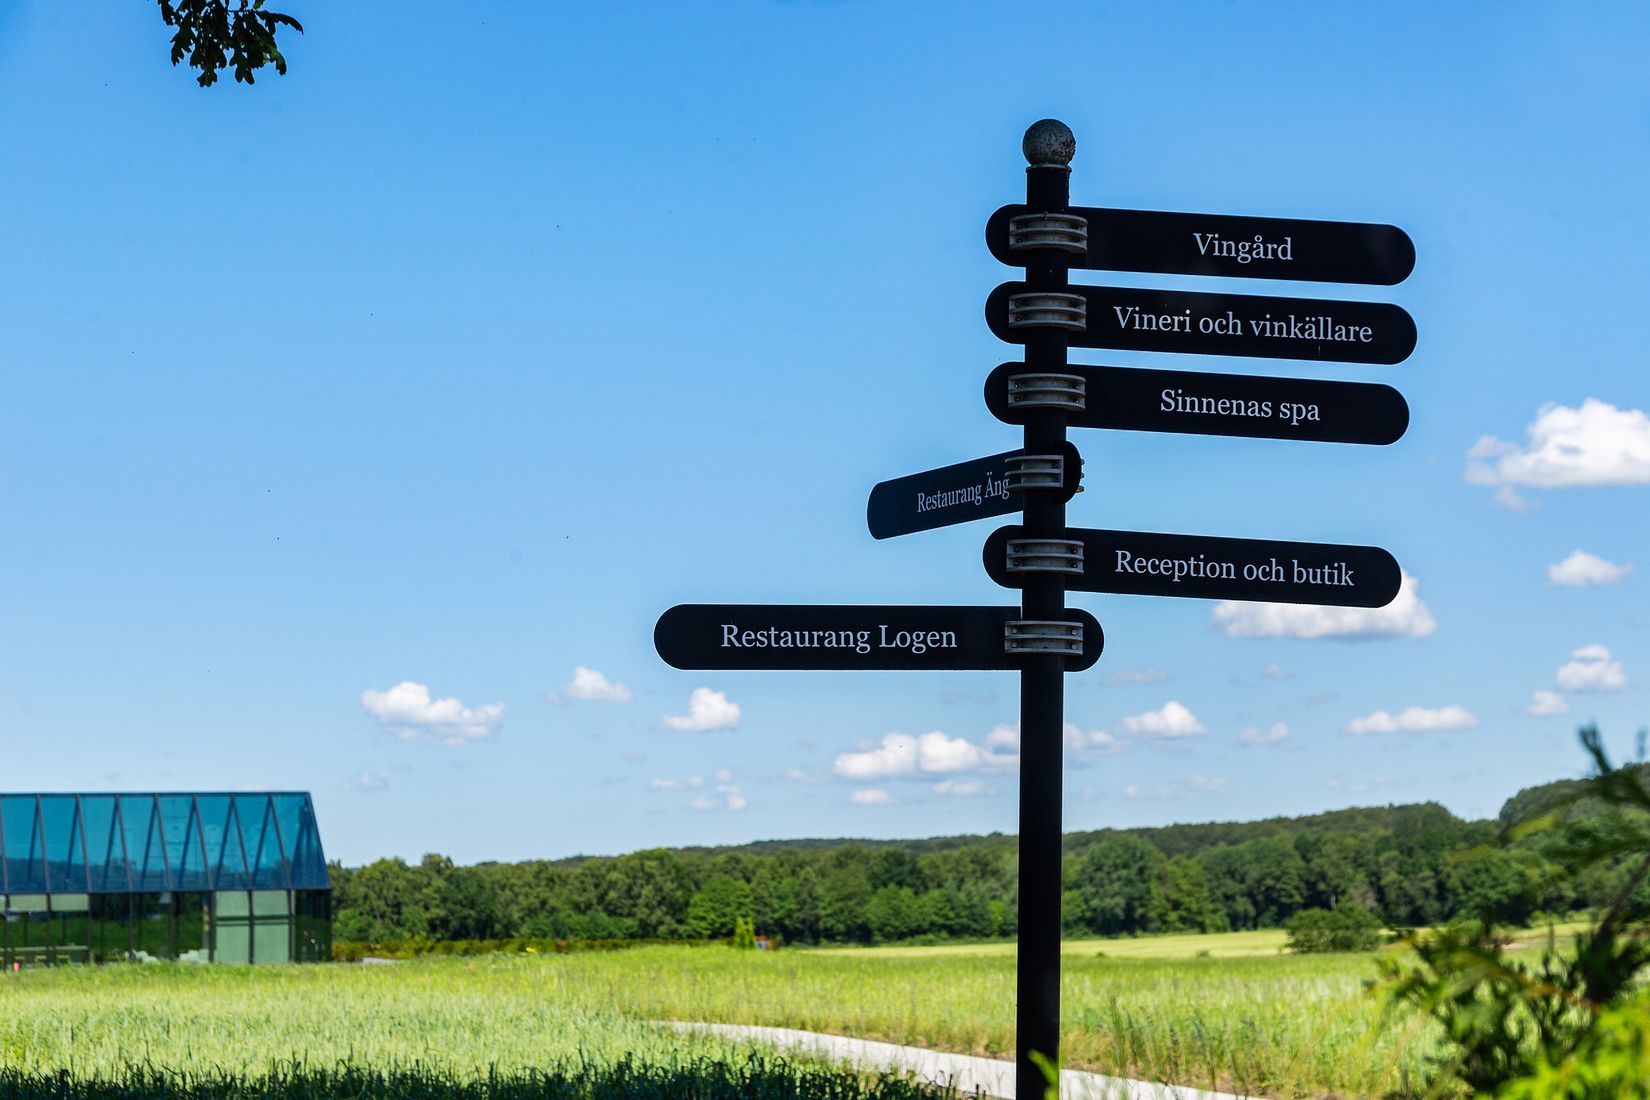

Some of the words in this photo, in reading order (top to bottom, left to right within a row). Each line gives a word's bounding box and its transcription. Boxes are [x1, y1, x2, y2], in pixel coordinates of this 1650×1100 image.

[1193, 232, 1294, 264] Vingård
[1113, 305, 1192, 333] Vineri
[1199, 311, 1243, 336] och
[1250, 313, 1373, 343] vinkällare
[1160, 388, 1273, 418] Sinnenas
[1279, 402, 1321, 426] spa
[917, 484, 982, 513] Restaurang
[984, 471, 1010, 500] Äng
[1115, 549, 1237, 583] Reception
[1243, 557, 1286, 582] och
[1292, 559, 1355, 586] butik
[721, 624, 871, 654] Restaurang
[879, 624, 958, 654] Logen
